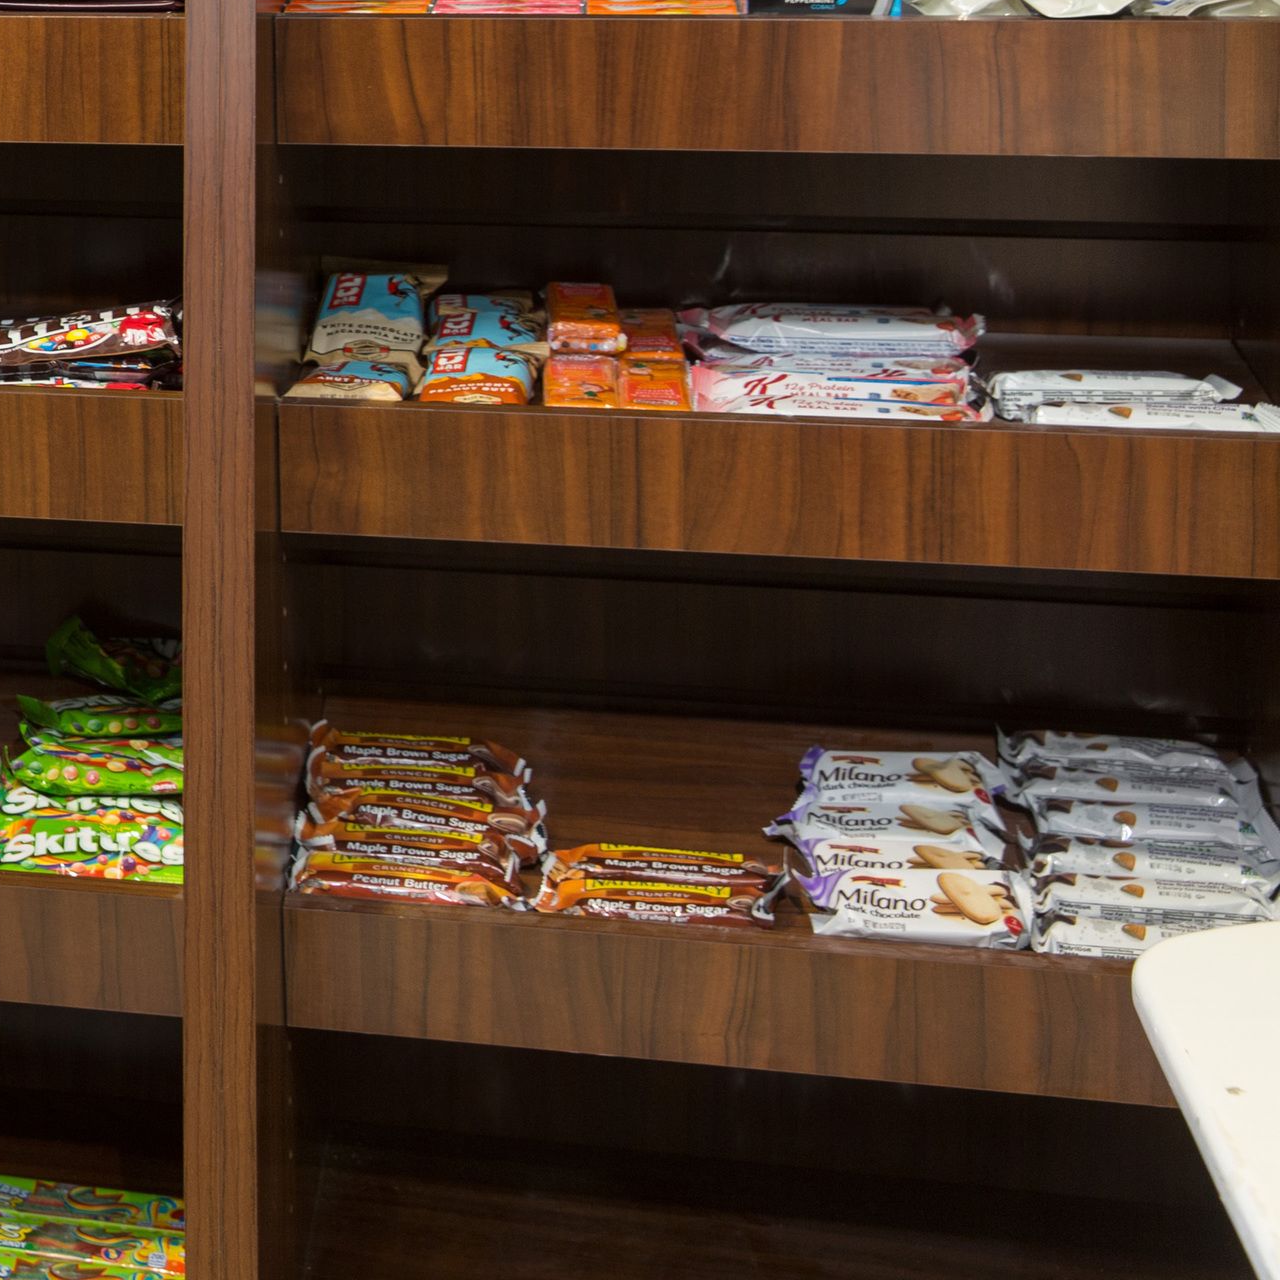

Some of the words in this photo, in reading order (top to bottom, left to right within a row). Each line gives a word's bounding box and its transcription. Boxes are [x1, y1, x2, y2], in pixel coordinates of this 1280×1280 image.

[321, 322, 355, 330] WHITE
[357, 323, 421, 340] CHOCOLATE
[326, 328, 389, 338] MACADAMIA
[429, 386, 478, 394] PEANUT
[744, 373, 788, 396] K
[784, 383, 806, 392] 12g
[809, 383, 855, 392] Protein
[343, 745, 383, 757] Maple
[386, 747, 428, 758] Brown
[432, 750, 472, 761] Sugar
[819, 766, 902, 784] Milano
[388, 779, 432, 790] Brown
[436, 783, 476, 794] Sugar
[822, 782, 847, 791] dark
[849, 782, 897, 792] chocolate
[358, 803, 398, 817] Maple
[401, 809, 445, 825] Brown
[448, 816, 490, 832] Sugar
[807, 812, 892, 827] Milano
[815, 854, 904, 869] Milano
[352, 873, 400, 887] Peanut
[404, 878, 449, 892] Butter
[844, 902, 868, 914] dark
